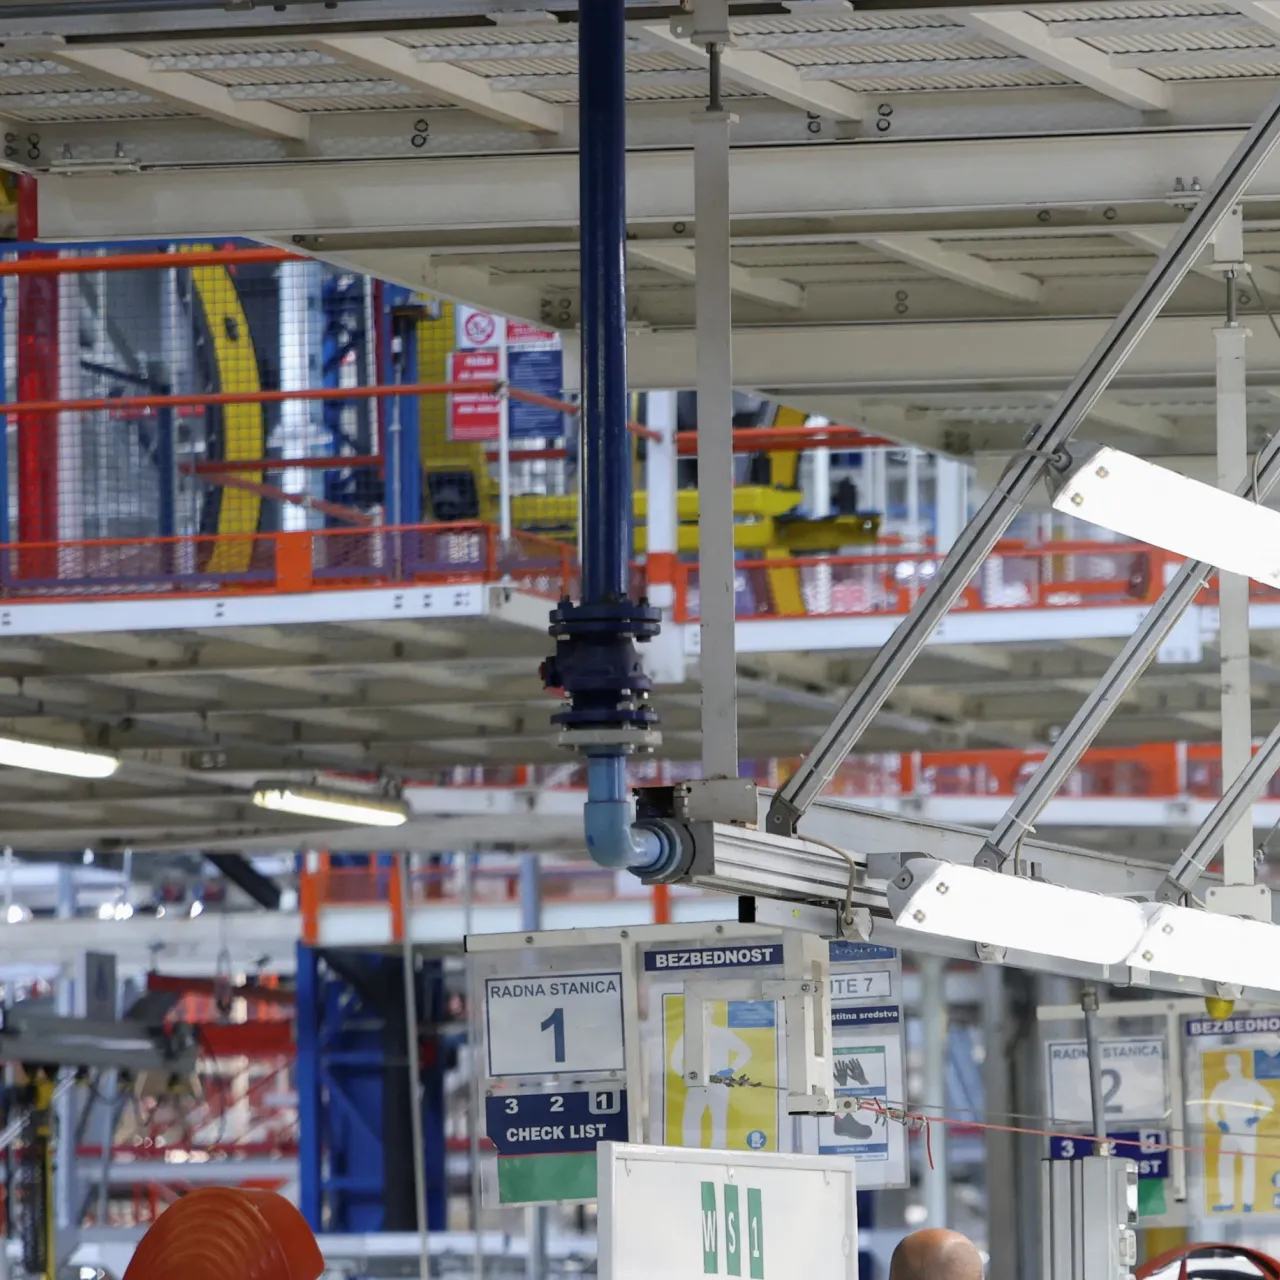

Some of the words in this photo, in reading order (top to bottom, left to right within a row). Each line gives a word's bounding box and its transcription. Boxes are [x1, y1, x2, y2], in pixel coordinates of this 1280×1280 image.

[656, 948, 773, 968] BEZBEDNOST
[491, 984, 546, 999] RADNA
[550, 980, 617, 996] STANICA
[864, 977, 873, 992] 7
[831, 1012, 857, 1021] stitna
[859, 1010, 898, 1020] sredstva
[541, 1008, 566, 1063] 1
[1053, 1047, 1089, 1060] RADN
[1100, 1068, 1123, 1114] 2
[505, 1098, 519, 1114] 3
[550, 1096, 564, 1112] 2
[596, 1093, 608, 1110] 1
[506, 1125, 565, 1142] CHECK
[570, 1123, 607, 1139] LIST
[1061, 1140, 1075, 1157] 3
[1139, 1160, 1162, 1175] ST
